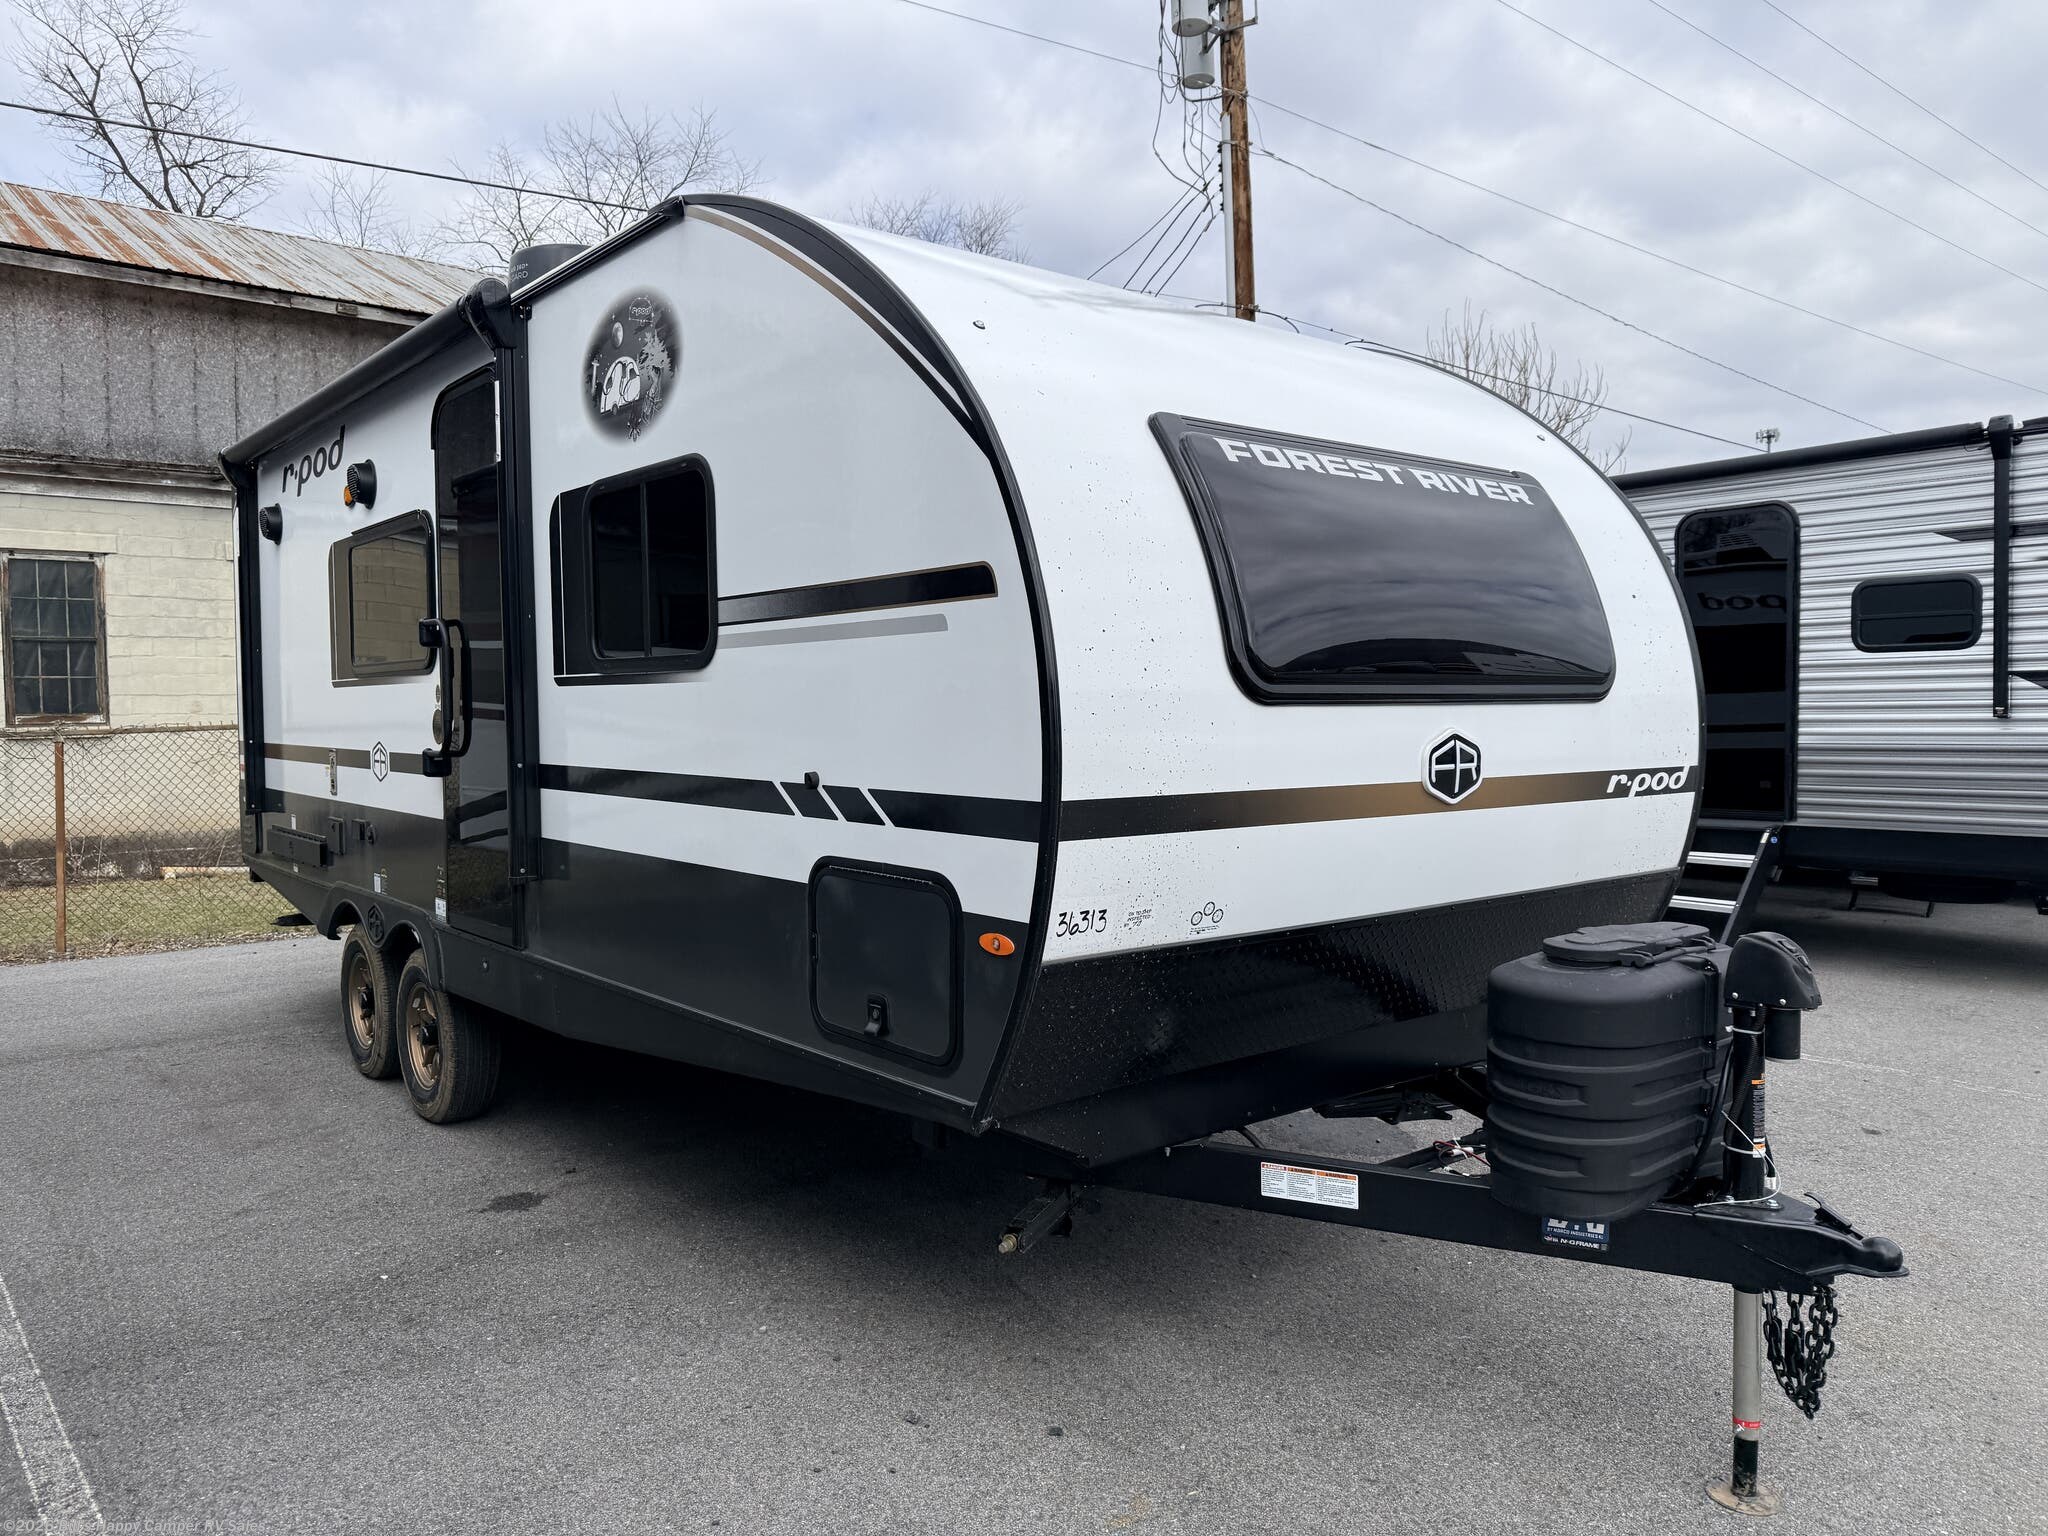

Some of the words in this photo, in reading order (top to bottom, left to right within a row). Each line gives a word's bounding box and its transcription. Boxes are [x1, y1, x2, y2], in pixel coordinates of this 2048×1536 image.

[1213, 437, 1403, 485] FOREST
[1407, 468, 1535, 505] RIVER
[1056, 908, 1108, 938] 36313
